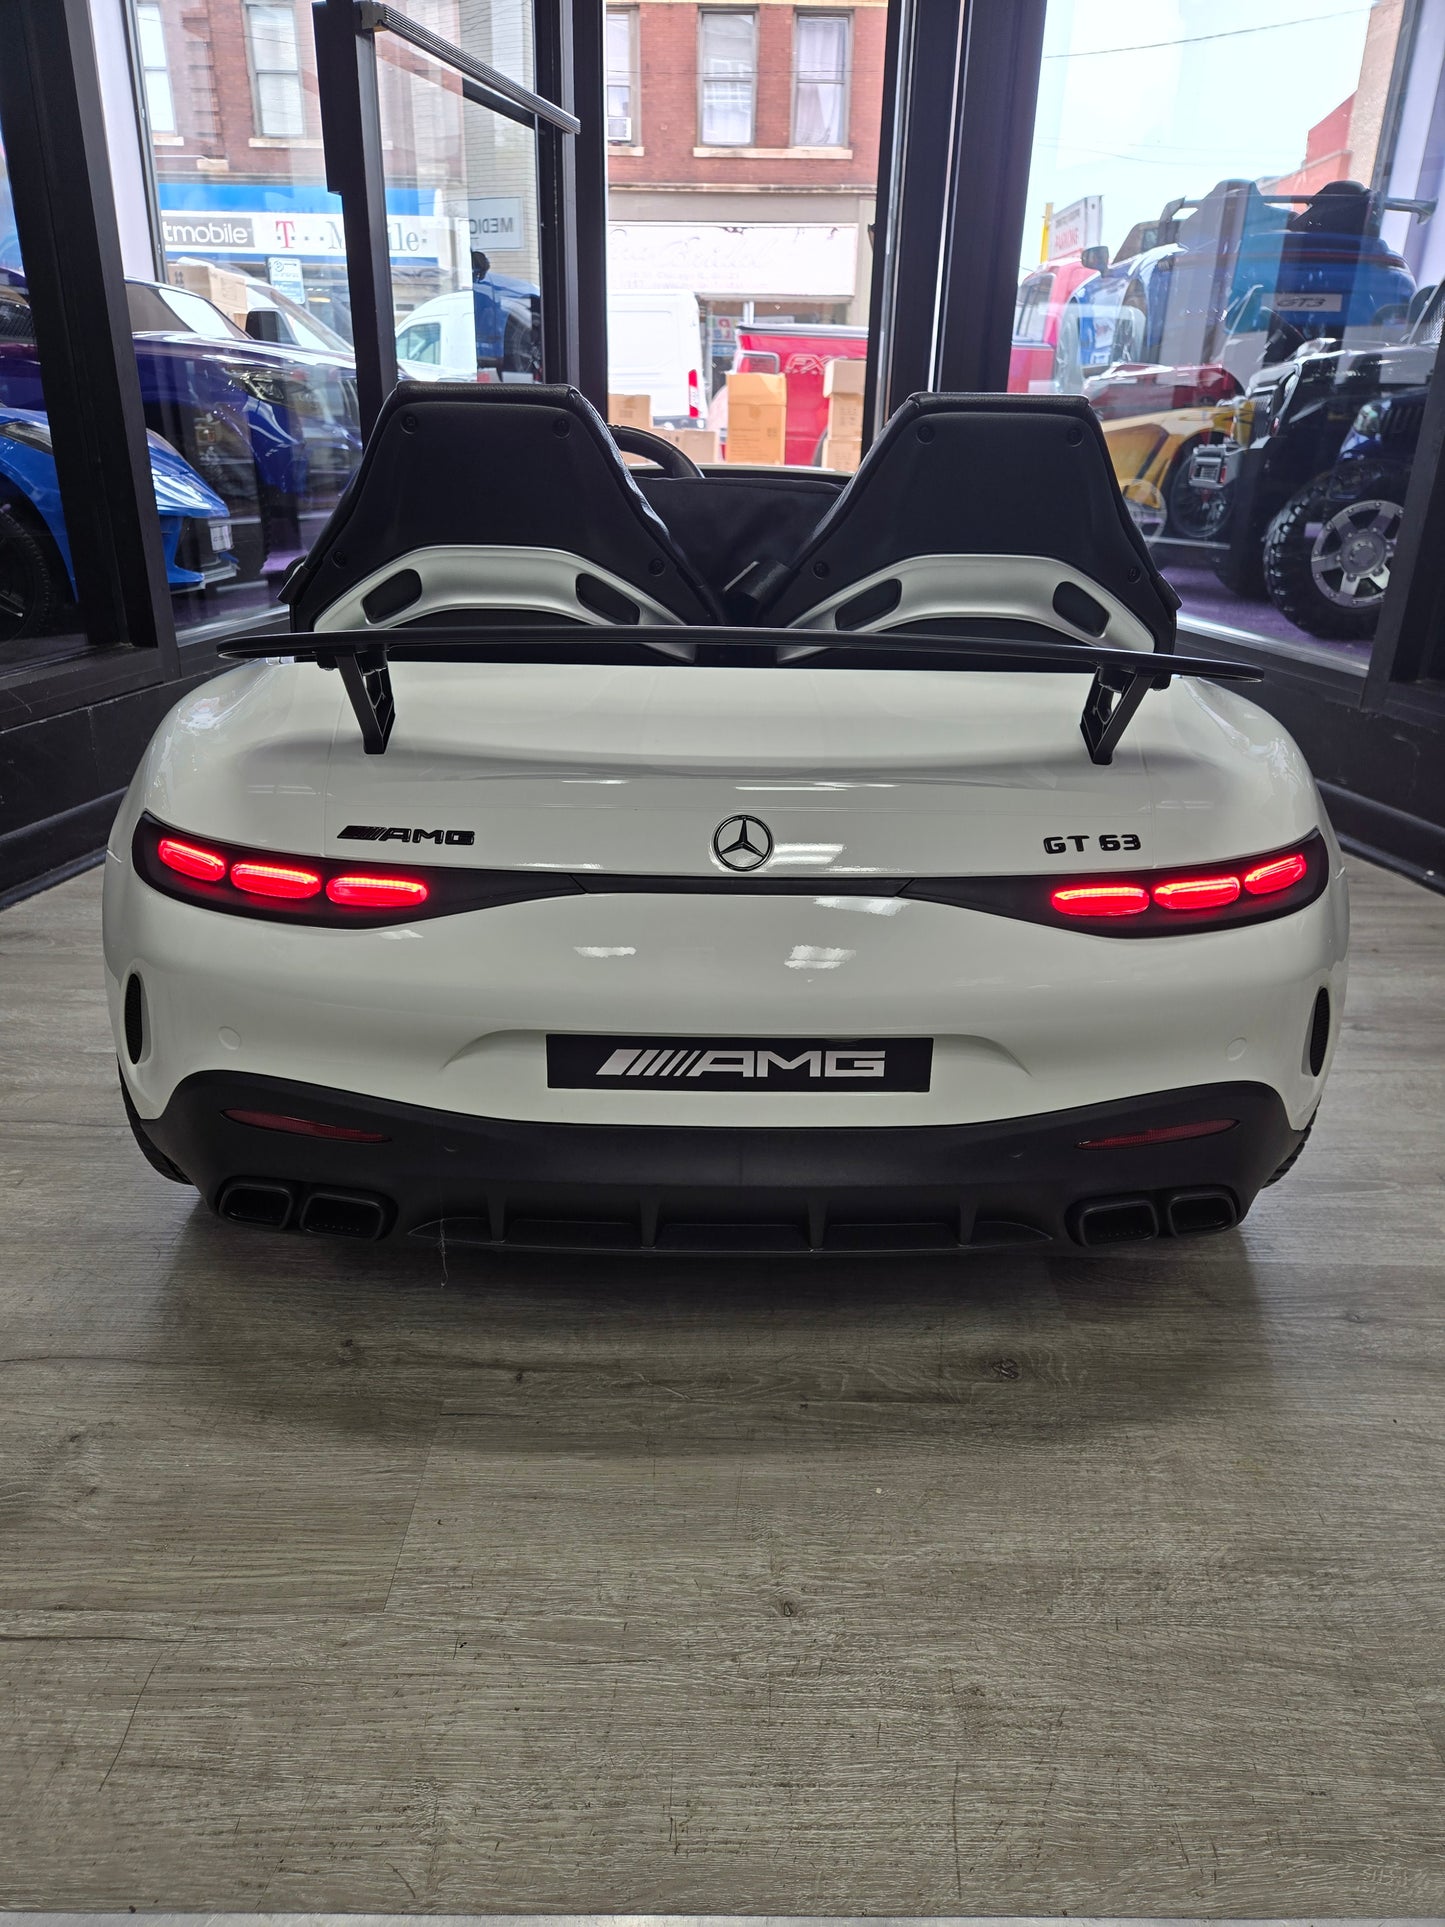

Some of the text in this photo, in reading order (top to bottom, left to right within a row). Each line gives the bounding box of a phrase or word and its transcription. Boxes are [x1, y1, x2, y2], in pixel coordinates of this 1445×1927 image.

[1276, 297, 1327, 308] GT3
[786, 353, 846, 373] FX
[378, 827, 475, 846] AMG
[1043, 834, 1142, 855] GT 63
[685, 1049, 886, 1078] AMG
